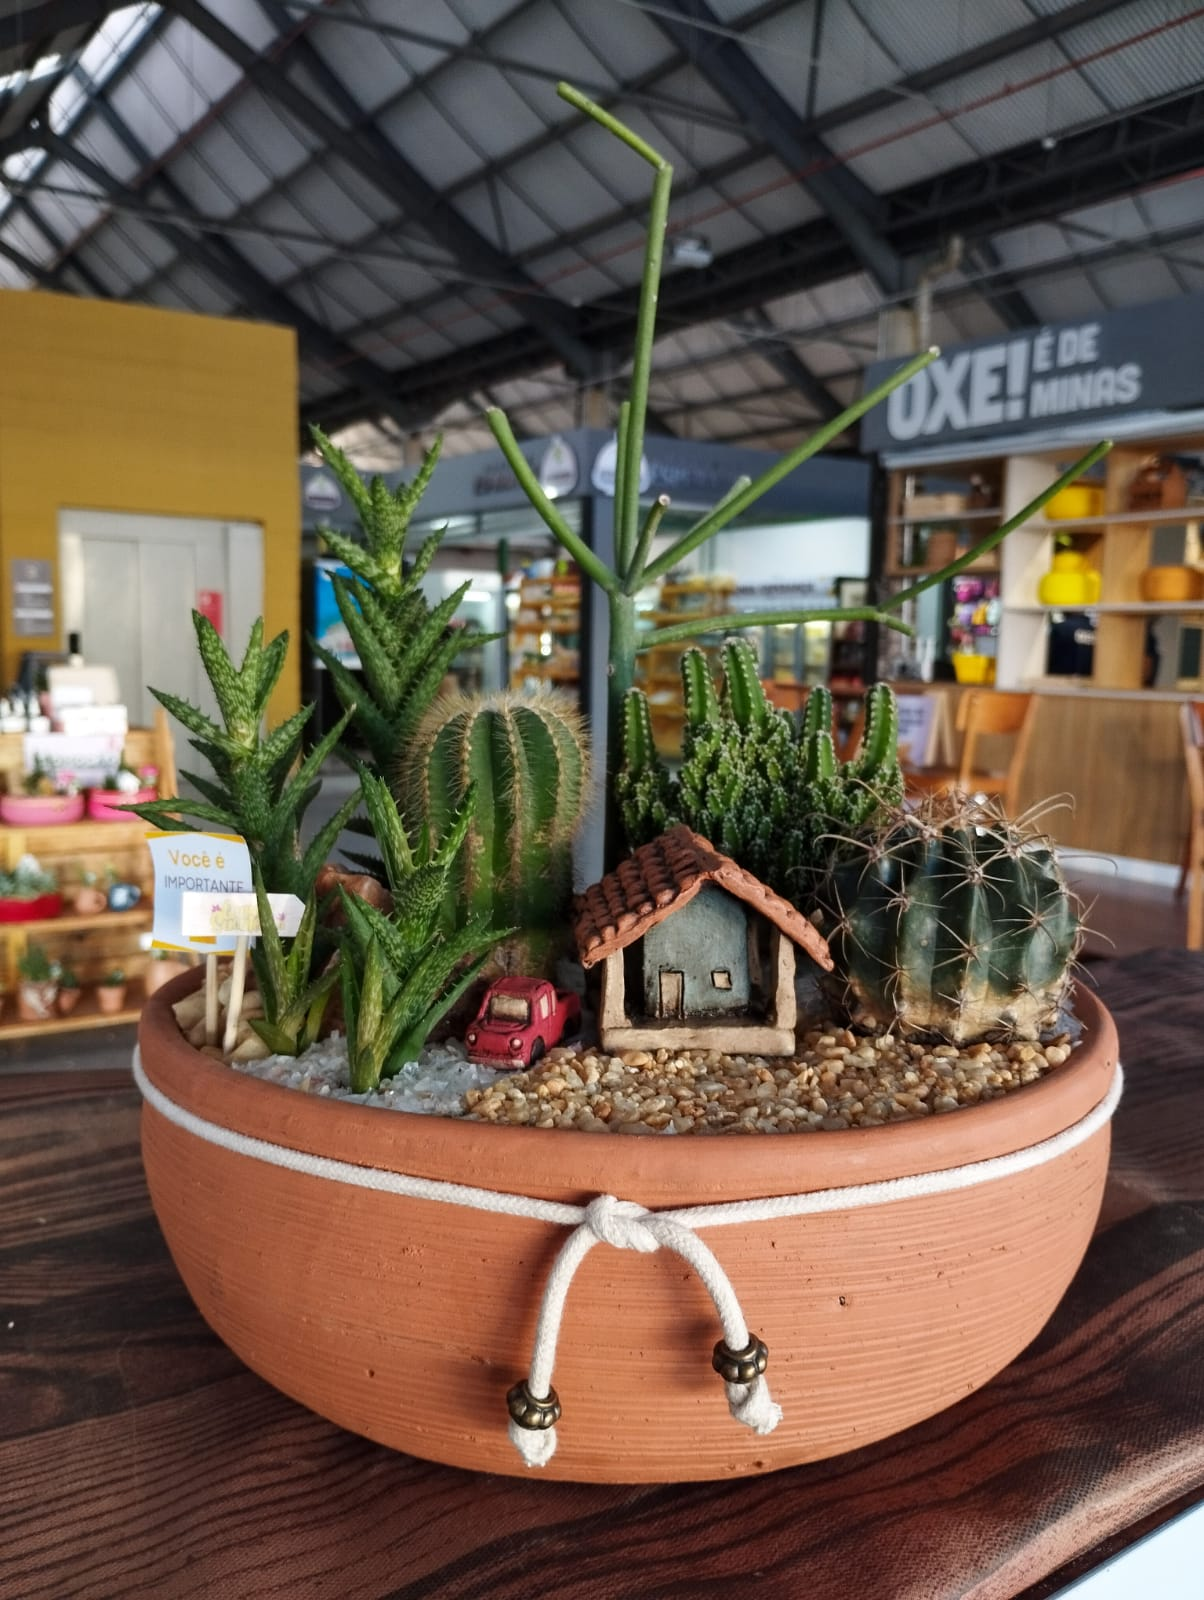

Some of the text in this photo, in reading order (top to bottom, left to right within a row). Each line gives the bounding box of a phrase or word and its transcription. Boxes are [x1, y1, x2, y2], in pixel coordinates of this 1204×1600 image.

[1034, 323, 1101, 372] É DE
[887, 339, 1030, 441] OXE!
[1031, 364, 1141, 418] MINAS
[165, 876, 244, 892] IMPORTANTE
[169, 850, 225, 869] Você é
